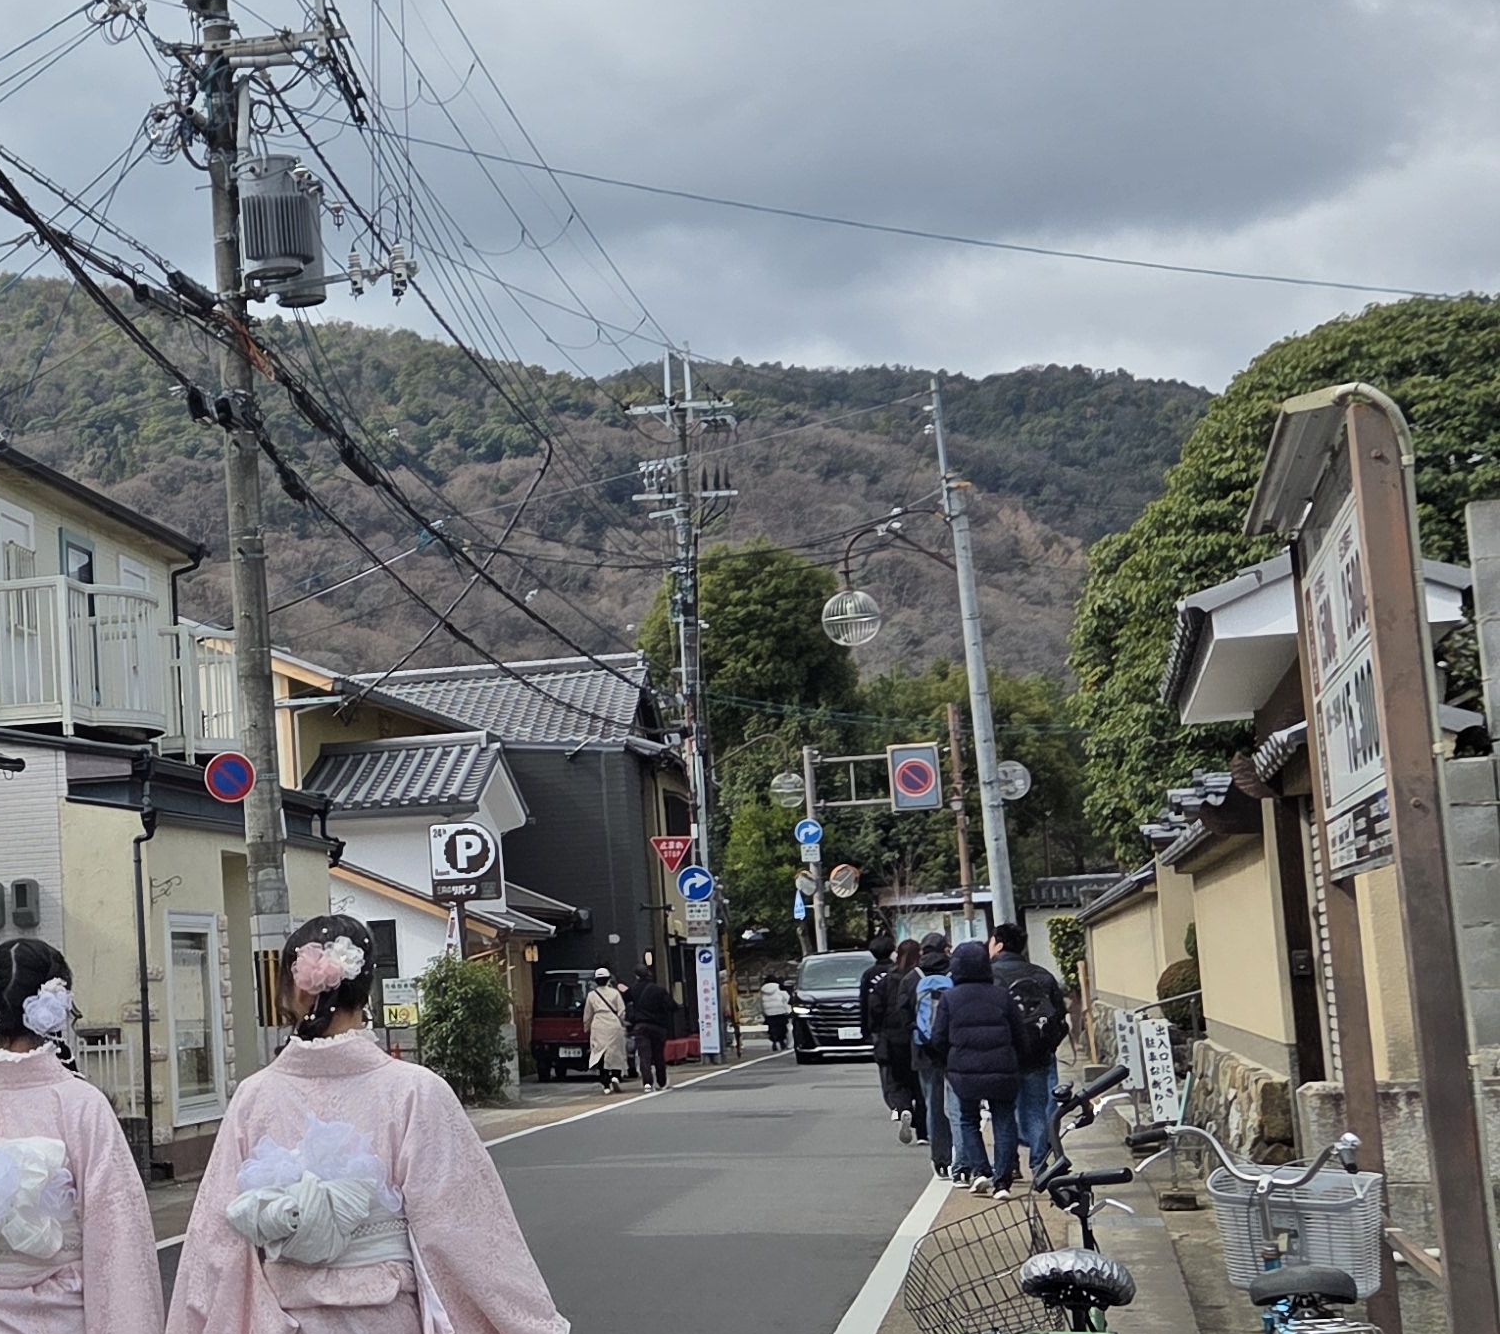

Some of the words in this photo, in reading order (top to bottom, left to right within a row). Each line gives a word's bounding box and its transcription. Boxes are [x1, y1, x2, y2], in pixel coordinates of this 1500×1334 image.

[455, 834, 483, 870] P
[659, 840, 685, 850] 止まれ
[663, 850, 682, 859] STOP
[1155, 1024, 1174, 1098] 出入口につき
